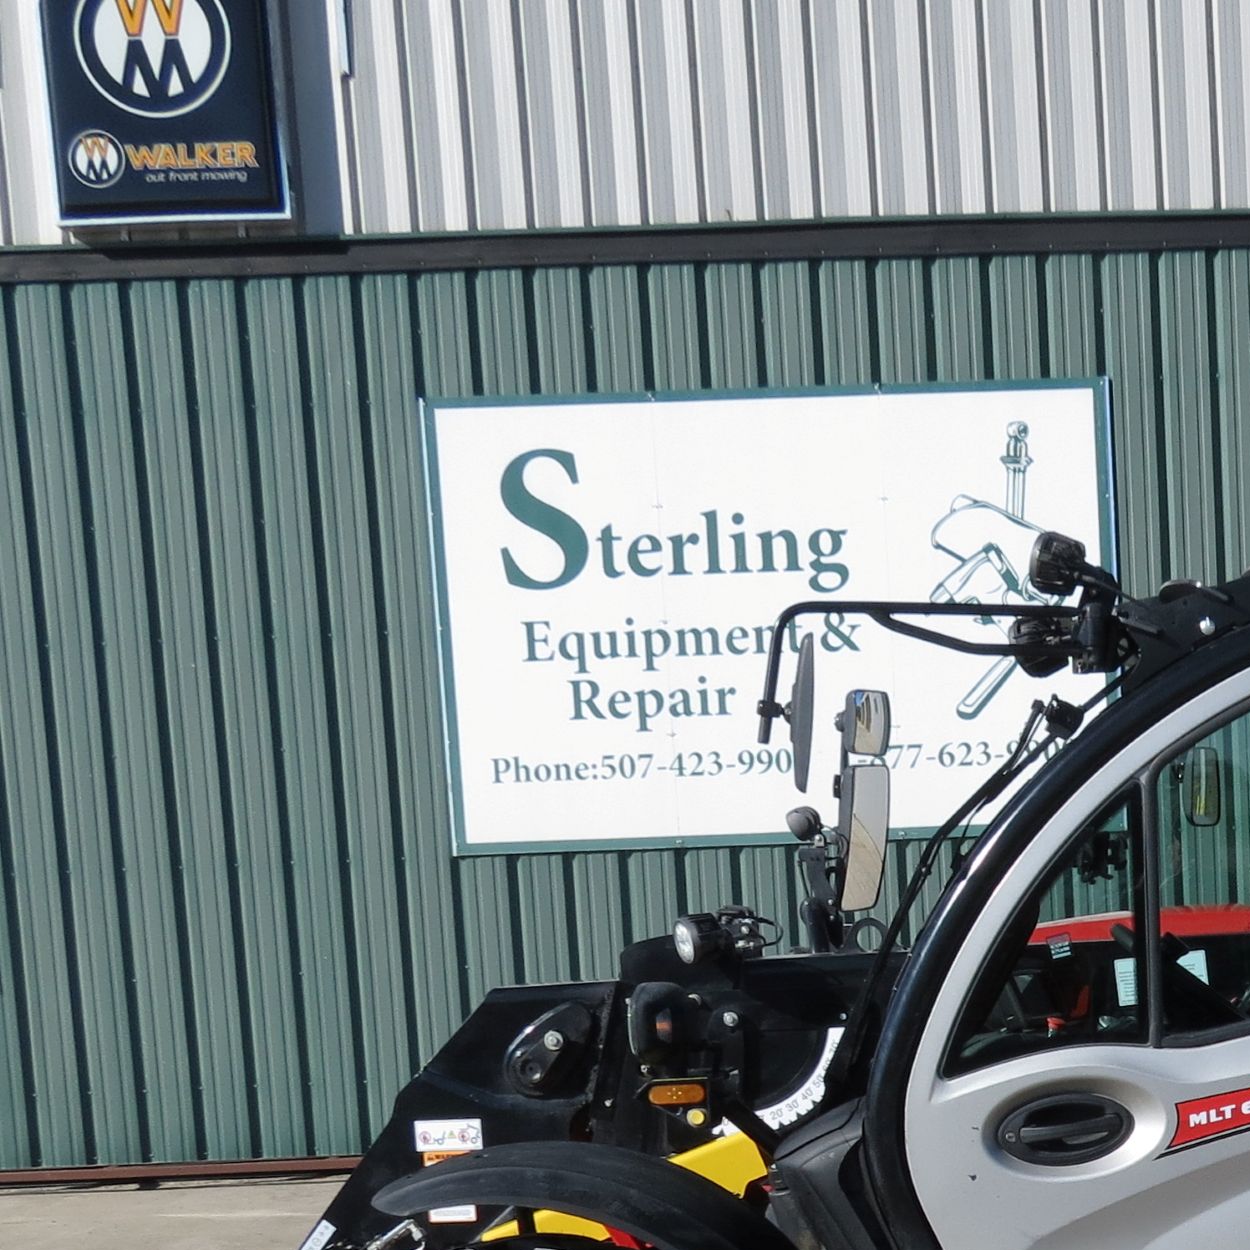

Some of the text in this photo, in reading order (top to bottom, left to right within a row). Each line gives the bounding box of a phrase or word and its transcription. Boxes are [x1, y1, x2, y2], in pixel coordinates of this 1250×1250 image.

[123, 141, 260, 171] WALKER
[145, 171, 248, 183] out front mowing
[499, 447, 850, 592] Sterling
[521, 611, 861, 674] Equipment &
[568, 675, 737, 731] Repair
[1188, 1104, 1236, 1128] MLT
